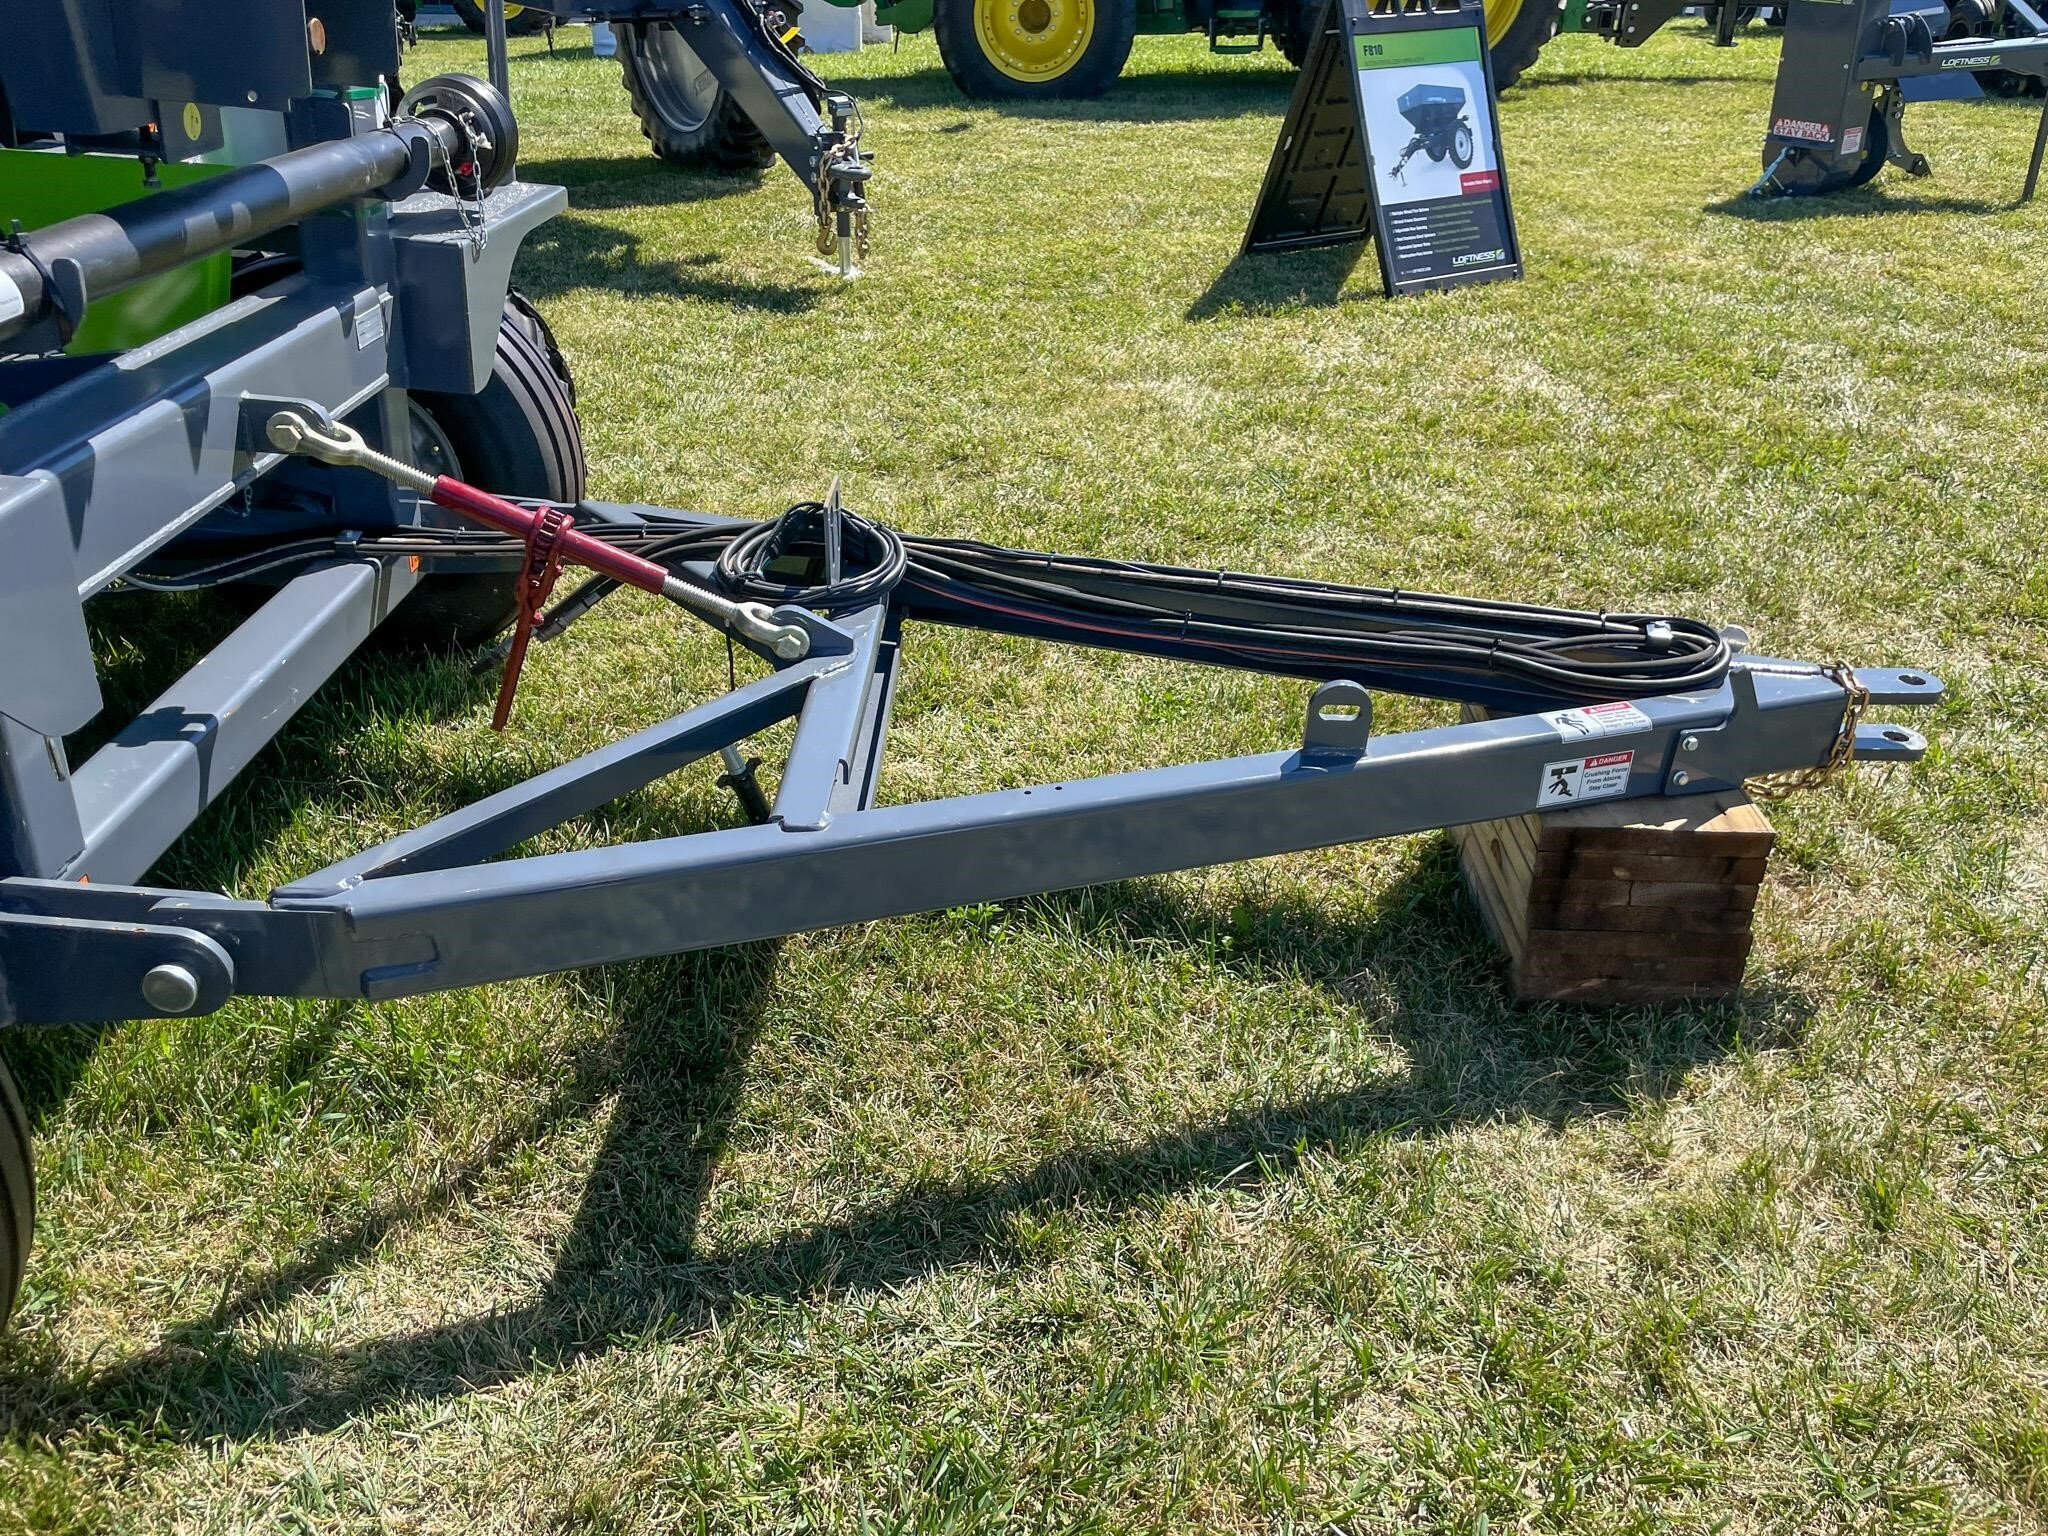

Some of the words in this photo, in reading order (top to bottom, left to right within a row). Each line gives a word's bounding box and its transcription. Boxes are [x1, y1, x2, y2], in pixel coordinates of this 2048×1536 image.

[1363, 44, 1383, 56] F810
[1941, 56, 1990, 67] LOFTNESS
[1784, 119, 1821, 131] DANGER
[1775, 126, 1800, 137] STAY
[1802, 130, 1827, 140] BACK
[1452, 250, 1495, 264] LOFTNESS
[1599, 754, 1628, 764] DANGER
[1584, 769, 1610, 778] Crushing
